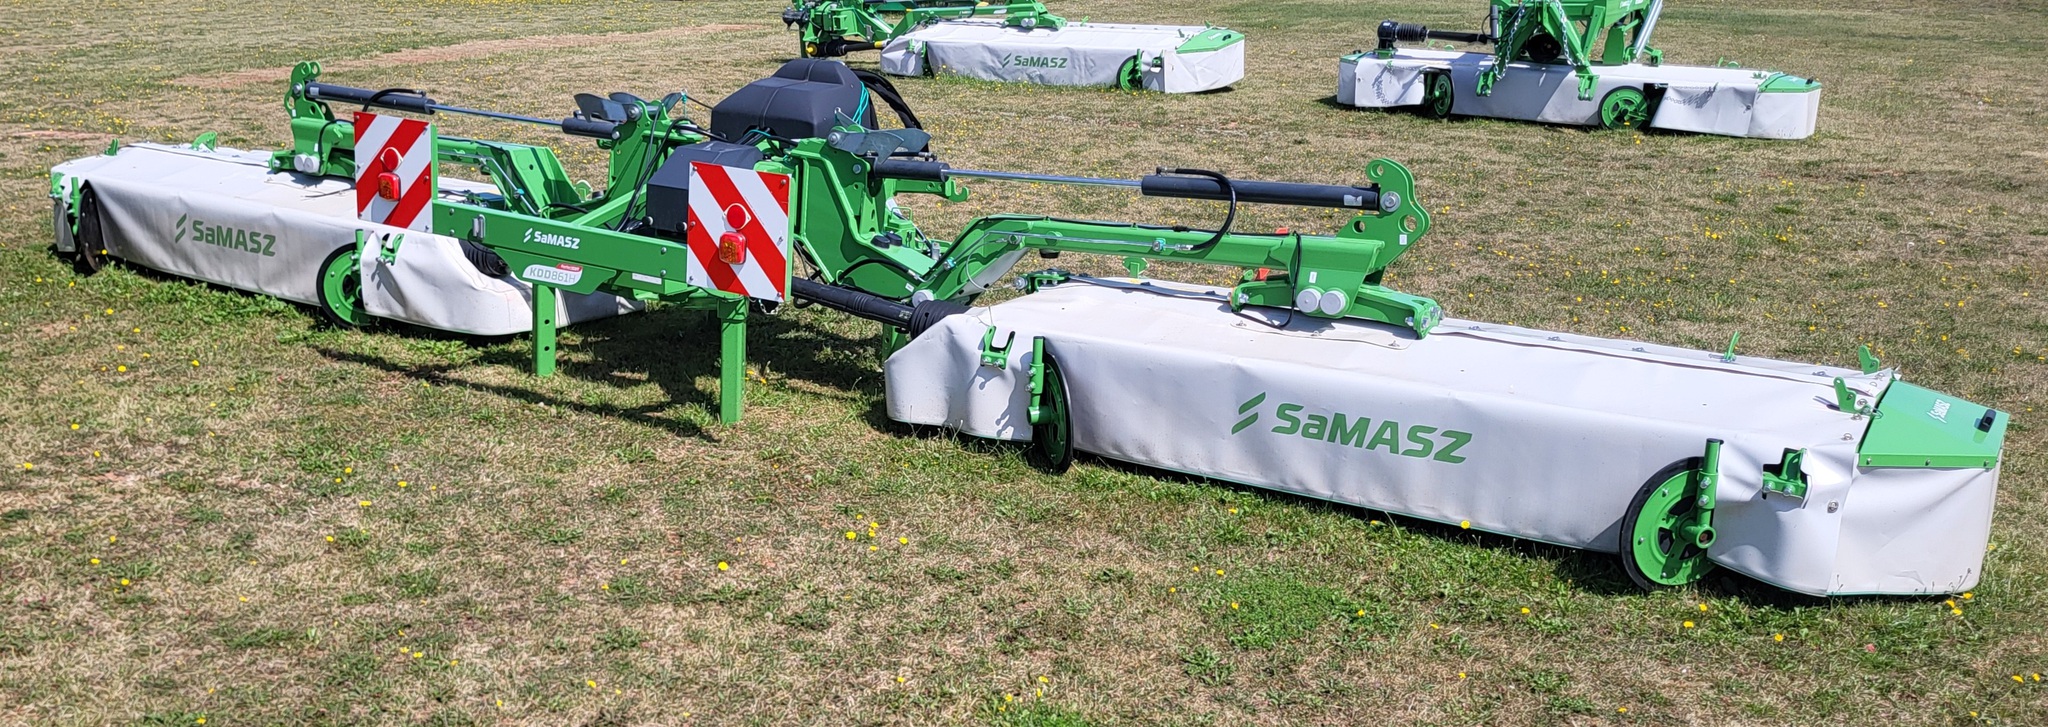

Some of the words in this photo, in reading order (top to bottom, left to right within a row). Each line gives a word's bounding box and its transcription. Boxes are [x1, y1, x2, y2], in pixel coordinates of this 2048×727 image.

[1013, 55, 1068, 69] SaMASZ
[192, 220, 276, 257] SaMASZ
[533, 231, 581, 250] SaMASZ
[1271, 403, 1473, 464] SaMASZ
